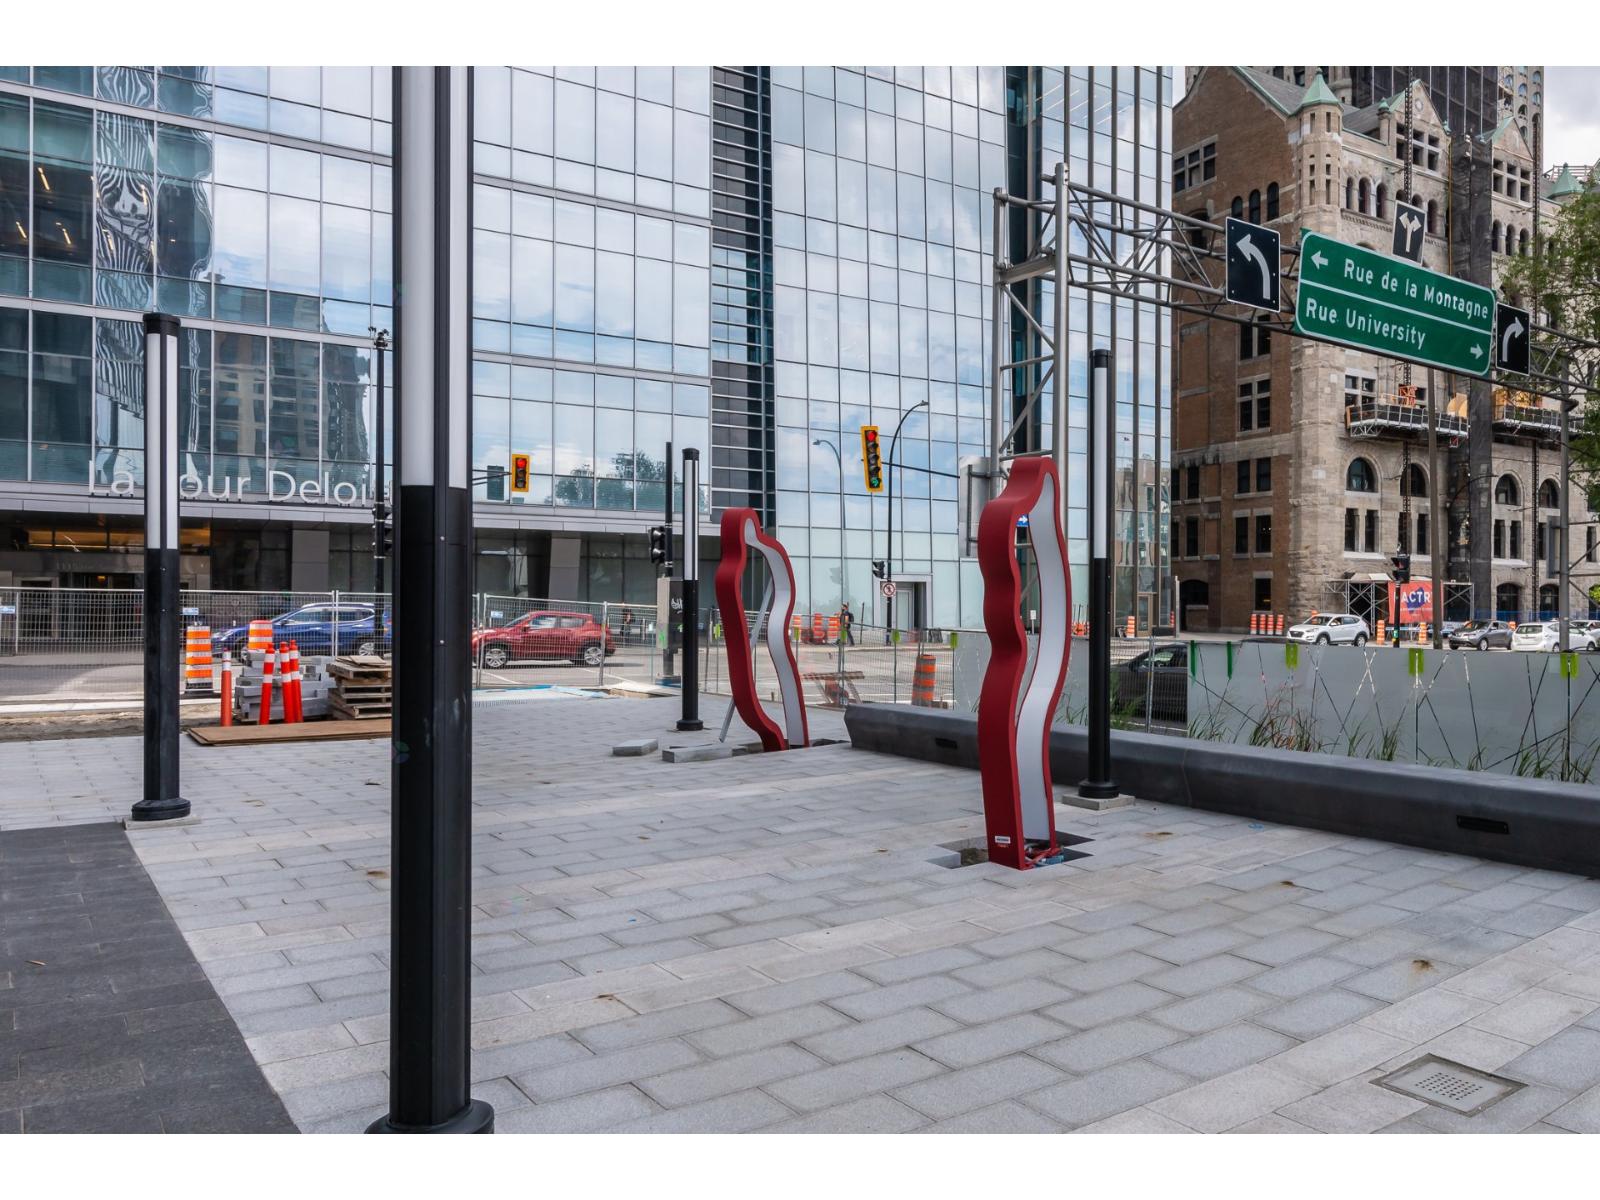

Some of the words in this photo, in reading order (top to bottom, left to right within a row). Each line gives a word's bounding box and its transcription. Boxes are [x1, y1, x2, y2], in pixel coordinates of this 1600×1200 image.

[1343, 258, 1374, 285] Rue
[1381, 271, 1398, 292] de
[1405, 278, 1418, 299] la
[1423, 284, 1488, 320] Montagne
[1305, 297, 1338, 324] Rue
[1345, 308, 1426, 350] University
[88, 460, 135, 496] La
[179, 473, 251, 500] our
[268, 470, 392, 506] Deloi
[1394, 591, 1433, 604] ACTR
